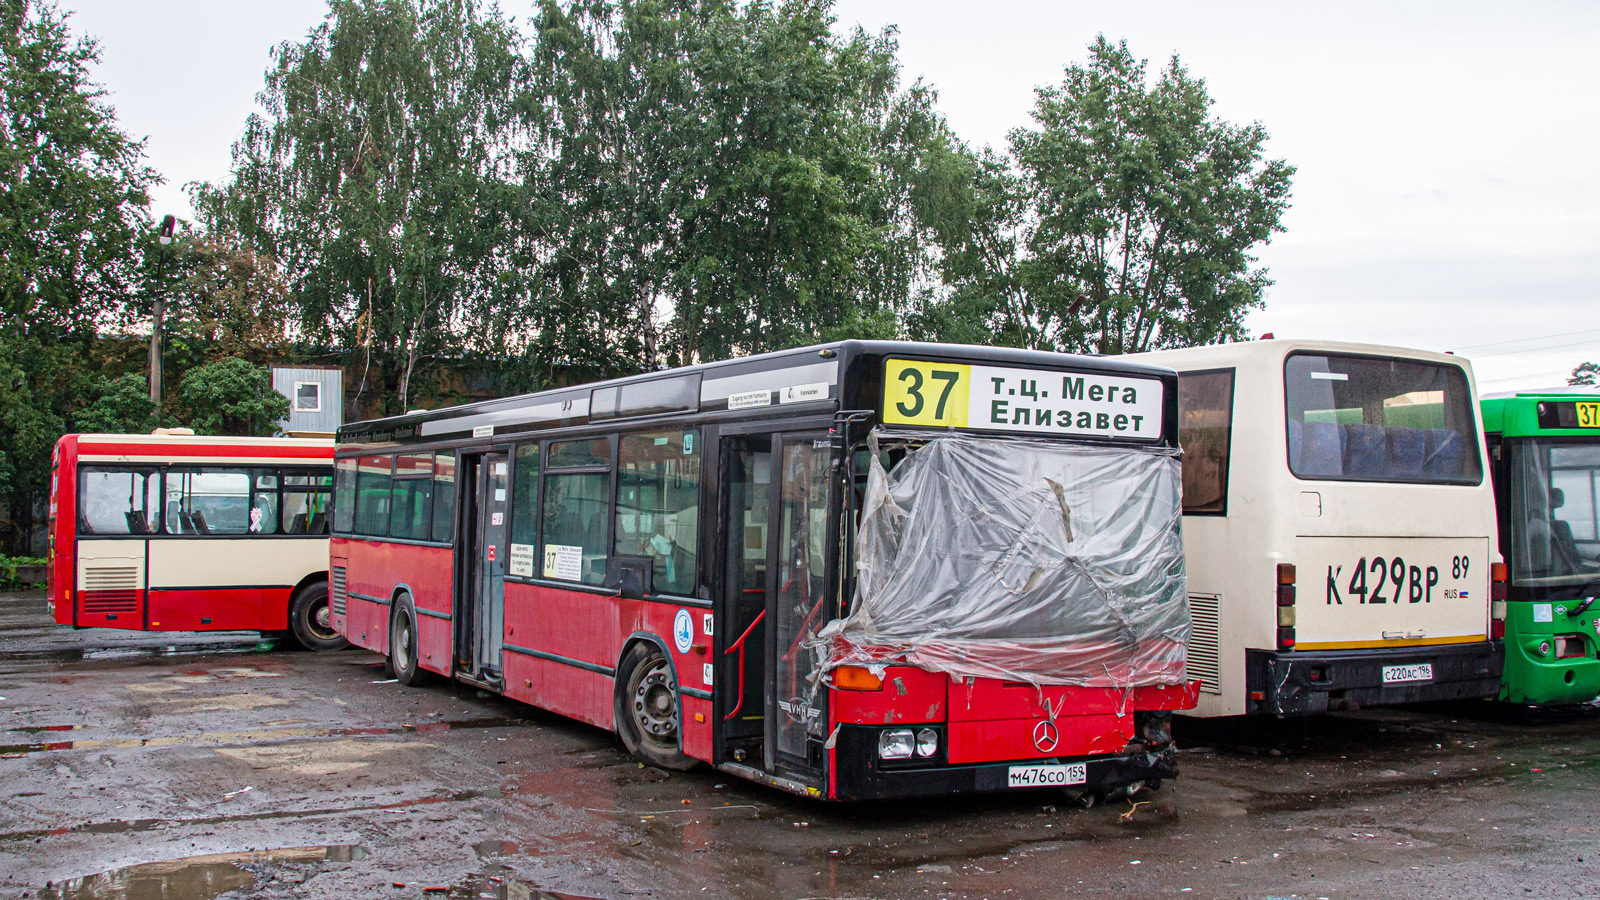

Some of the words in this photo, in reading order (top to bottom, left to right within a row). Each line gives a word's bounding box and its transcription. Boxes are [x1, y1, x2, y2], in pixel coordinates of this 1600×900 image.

[895, 367, 960, 420] 37
[990, 376, 1048, 401] т.ц.
[1061, 376, 1138, 404] Мега
[990, 400, 1144, 432] Елизавет
[1580, 404, 1598, 426] 37
[546, 552, 556, 570] 37
[1452, 555, 1470, 579] 89
[1444, 589, 1458, 599] RUS
[1418, 665, 1430, 675] 196
[1067, 766, 1084, 778] 159
